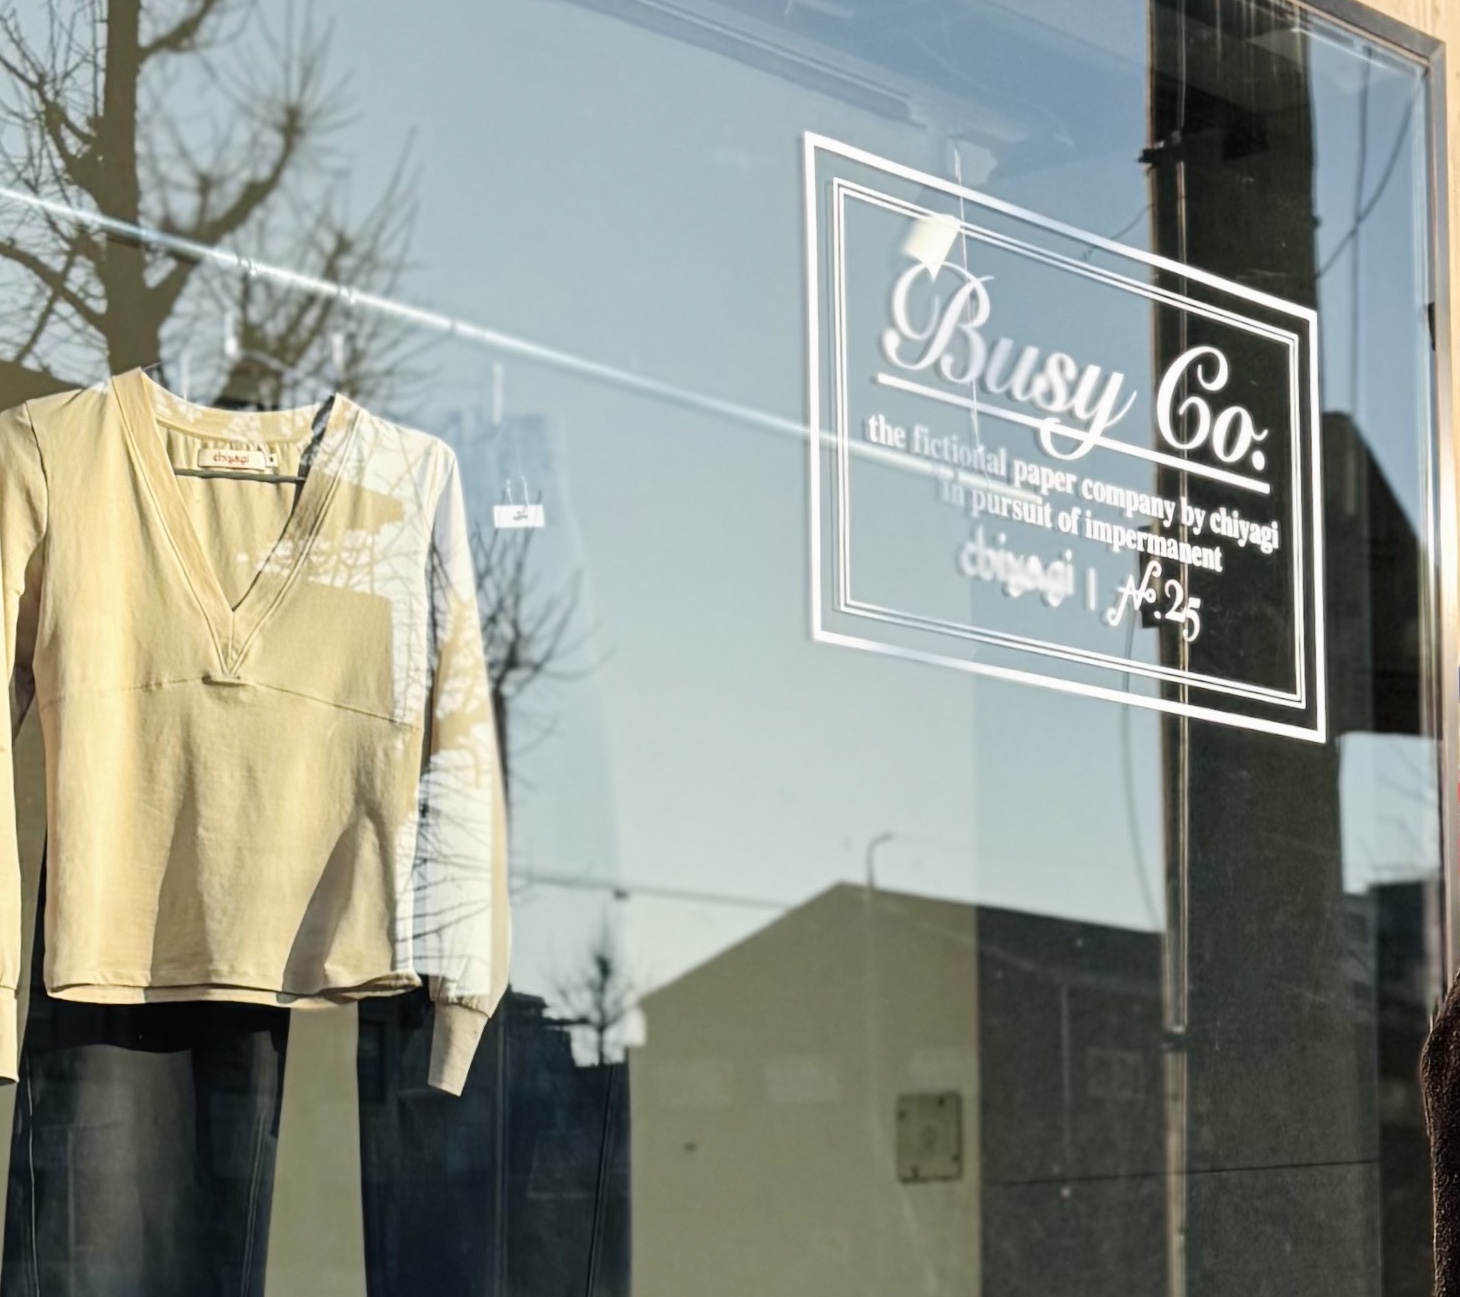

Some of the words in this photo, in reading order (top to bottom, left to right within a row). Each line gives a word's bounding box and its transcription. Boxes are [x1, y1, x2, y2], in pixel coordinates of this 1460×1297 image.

[882, 262, 1138, 461] Busy
[1157, 346, 1268, 471] Co.
[867, 413, 906, 448] the
[912, 424, 1008, 477] fictional
[1013, 459, 1077, 496] paper
[1081, 478, 1176, 528] company
[1180, 496, 1206, 536] by
[1209, 506, 1280, 554] chiyagi
[971, 487, 1054, 528] pursuit
[1058, 506, 1082, 536] of
[1085, 509, 1223, 573] impermanent
